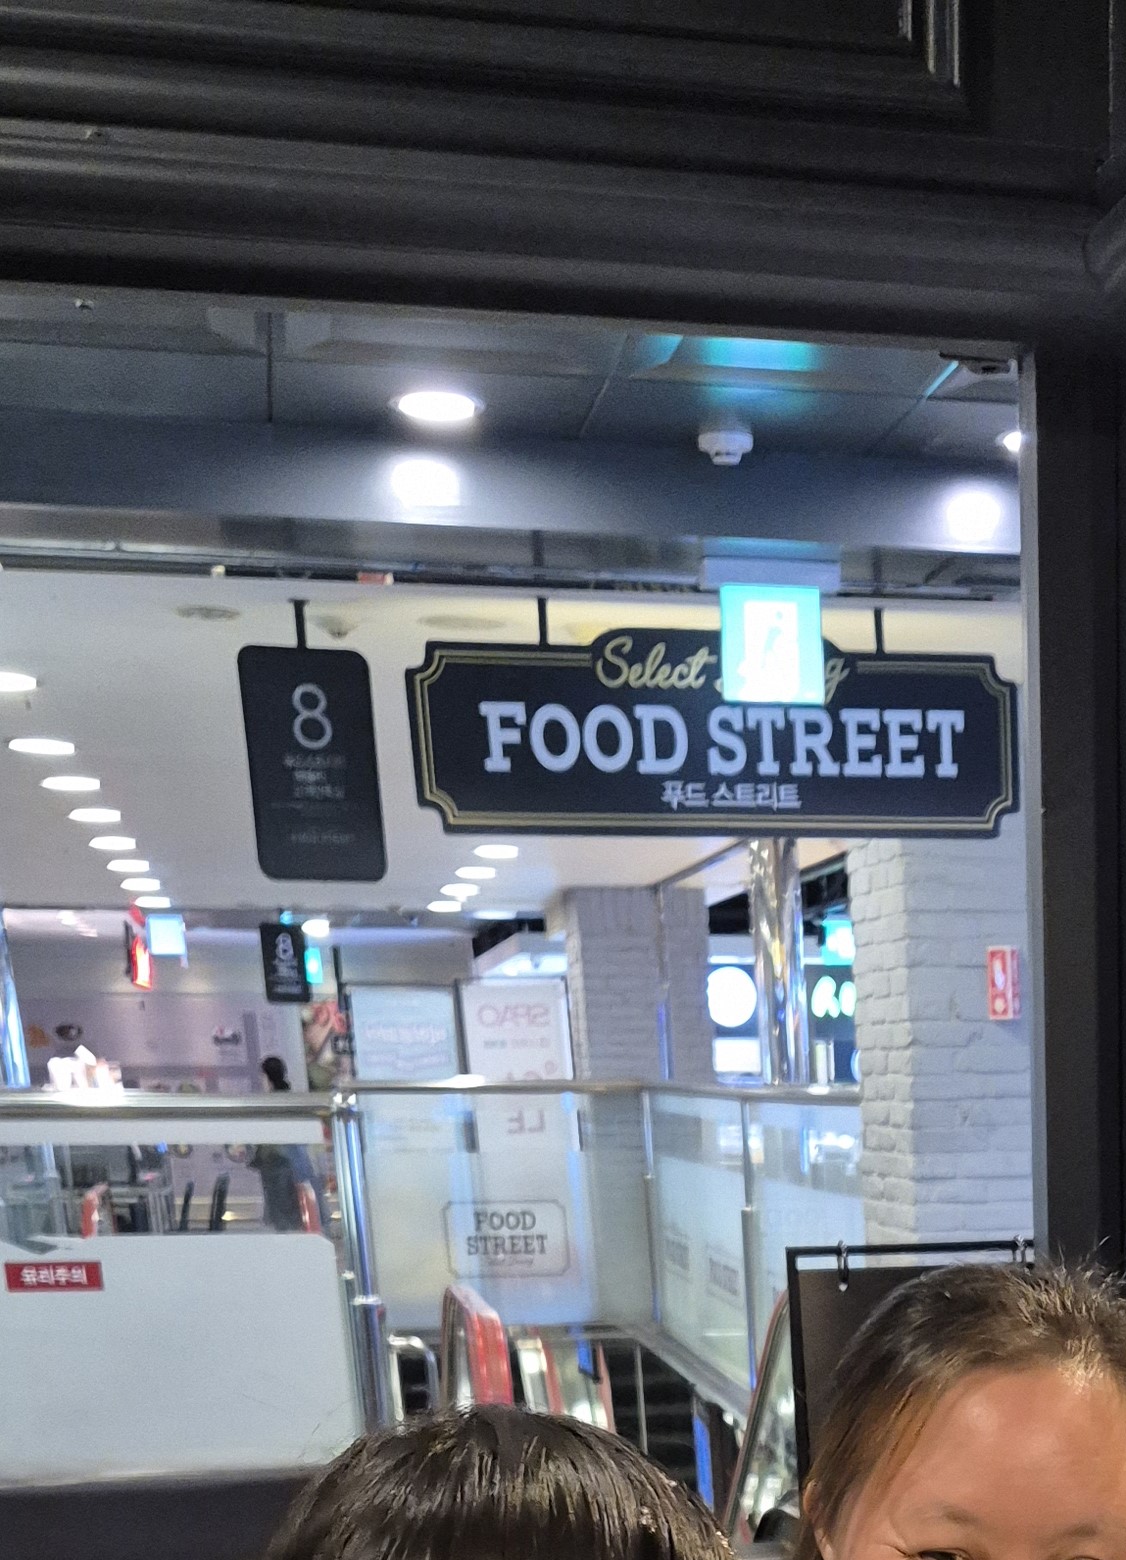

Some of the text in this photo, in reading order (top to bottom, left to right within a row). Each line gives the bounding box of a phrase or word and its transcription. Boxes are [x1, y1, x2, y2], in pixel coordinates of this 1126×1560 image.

[594, 635, 717, 690] Select
[292, 682, 333, 750] 8
[479, 701, 966, 779] FOOD STREET
[660, 780, 802, 812] 푸드 스트리트
[474, 1209, 537, 1231] FOOD
[466, 1233, 548, 1256] STREET
